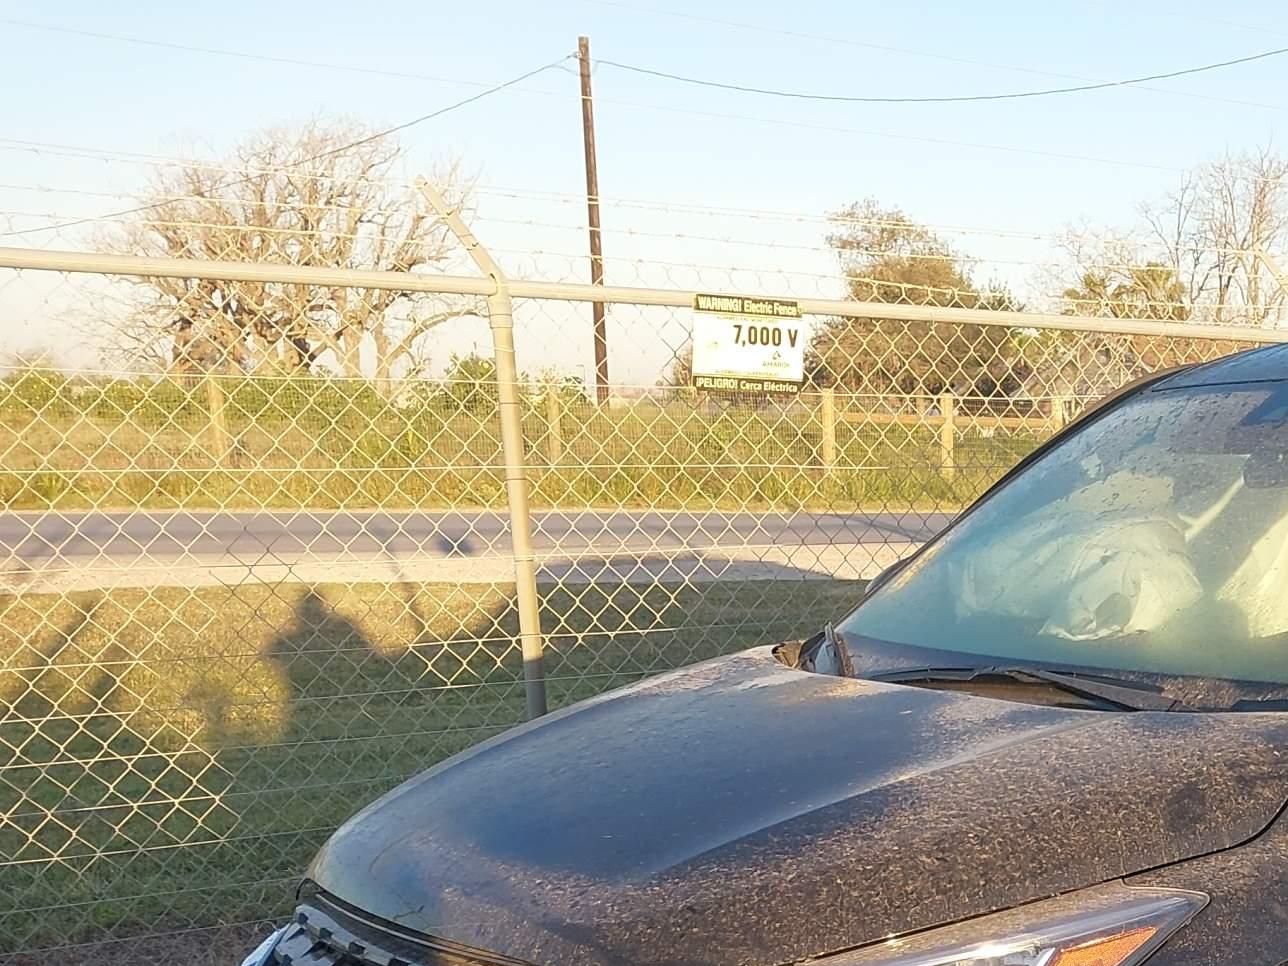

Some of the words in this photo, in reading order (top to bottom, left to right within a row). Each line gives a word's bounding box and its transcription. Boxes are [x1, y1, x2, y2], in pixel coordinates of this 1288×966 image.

[697, 296, 742, 312] WARNING!
[744, 299, 773, 314] Electric
[773, 302, 797, 316] Fence
[733, 324, 782, 347] 7,000
[788, 329, 798, 348] V
[740, 380, 763, 391] Cerca
[763, 381, 798, 393] Eléctrica
